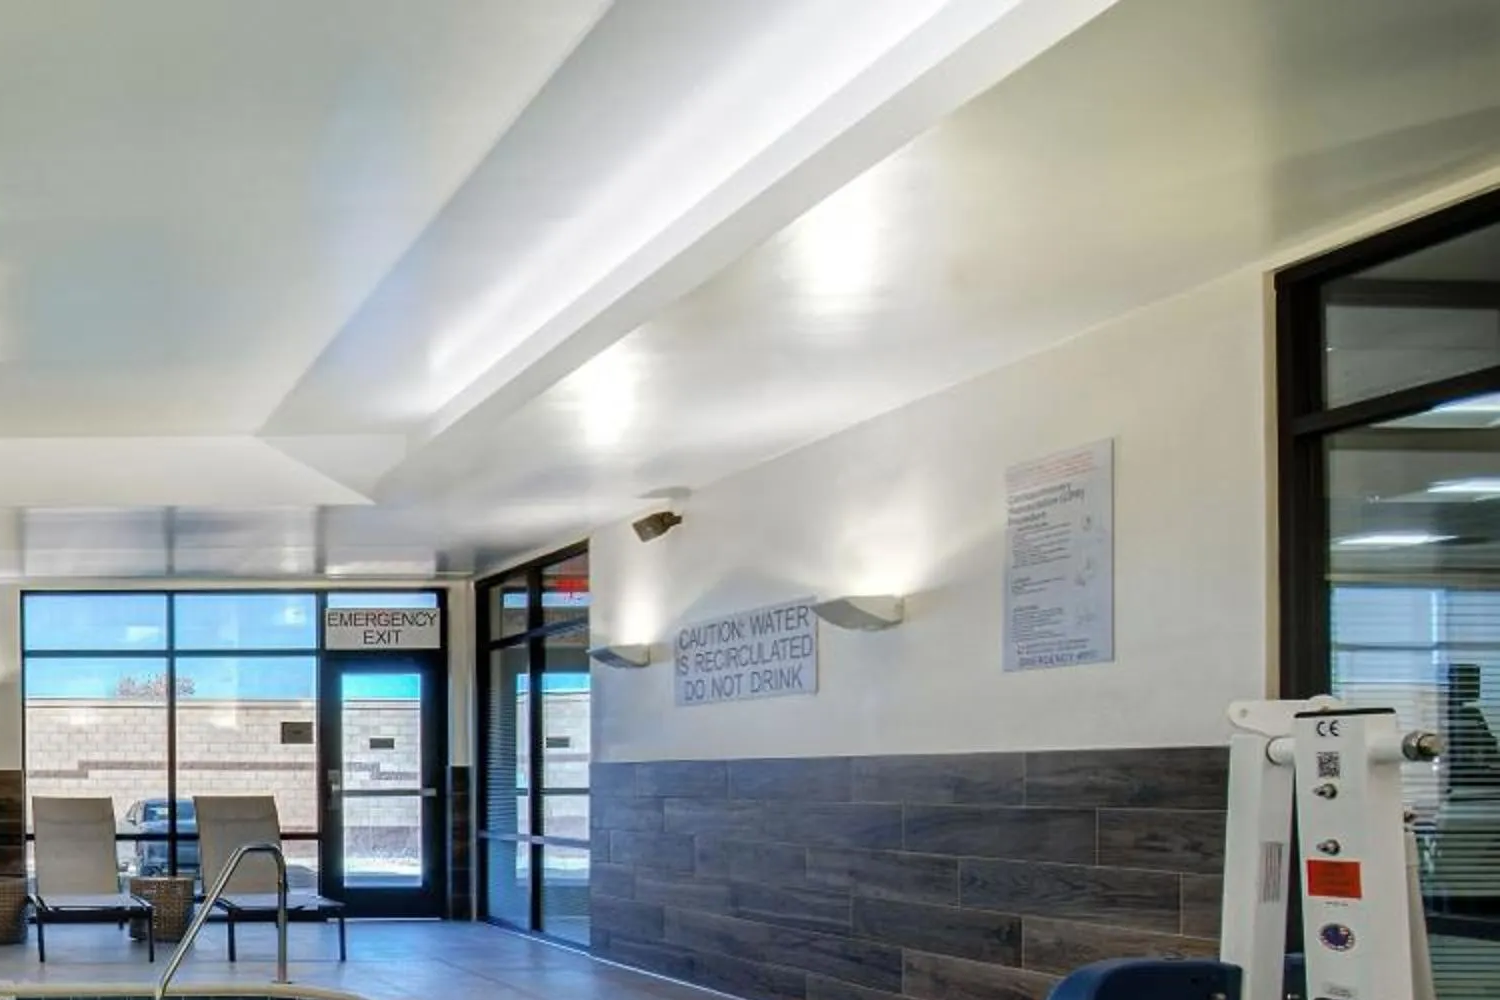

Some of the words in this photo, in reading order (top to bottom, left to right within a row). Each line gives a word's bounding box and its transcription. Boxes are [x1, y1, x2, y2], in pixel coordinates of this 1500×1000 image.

[327, 612, 437, 627] EMERGENCY
[750, 606, 809, 636] WATER
[363, 629, 403, 645] EXIT
[694, 634, 813, 672] RECIRCULATED
[684, 679, 705, 701] DO
[710, 673, 743, 698] NOT
[750, 665, 803, 693] DRINK
